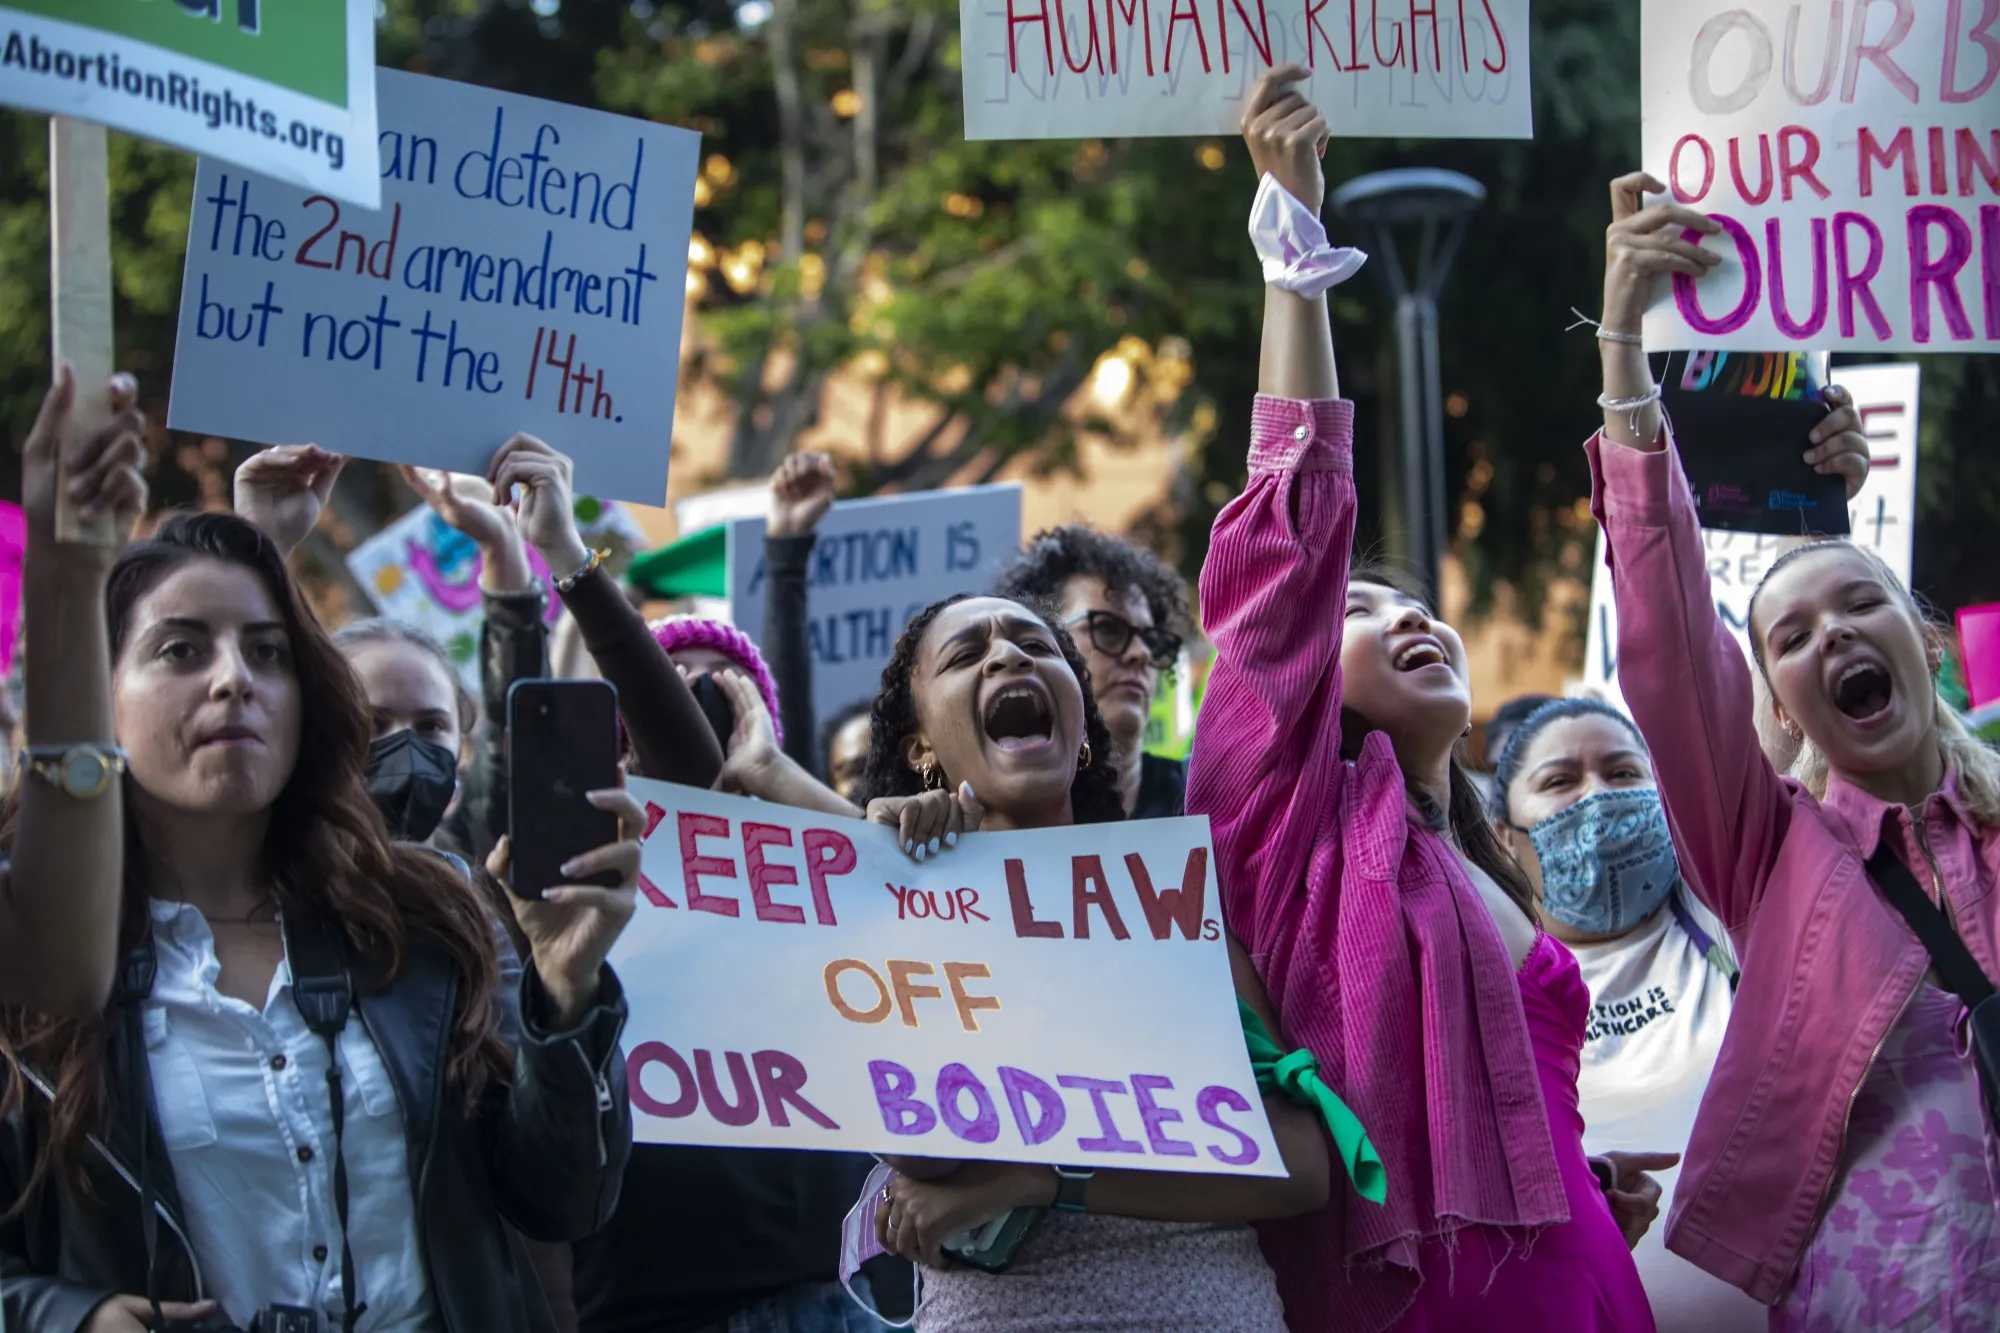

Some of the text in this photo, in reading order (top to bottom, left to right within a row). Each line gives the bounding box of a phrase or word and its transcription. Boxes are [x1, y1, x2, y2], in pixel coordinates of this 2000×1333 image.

[1004, 0, 1508, 77] HUMAN RIGHTS
[1688, 0, 2000, 115] OUR B
[0, 29, 345, 169] AbortionRights.org
[380, 106, 644, 231] an defend
[1669, 124, 2000, 206] OUR MIN
[206, 174, 657, 326] the 2nd amendment
[1672, 204, 2000, 343] OUR RI
[197, 274, 624, 423] but not the 14th.
[748, 521, 982, 595] RTION IS
[809, 604, 893, 664] ALTH
[637, 800, 857, 927] KEEP
[886, 881, 990, 925] YOUR
[823, 957, 1002, 1033] OFF
[1585, 1000, 1675, 1042] ALTHCARE
[1587, 997, 1643, 1023] RTION
[625, 1039, 1262, 1168] OUR BODIES
